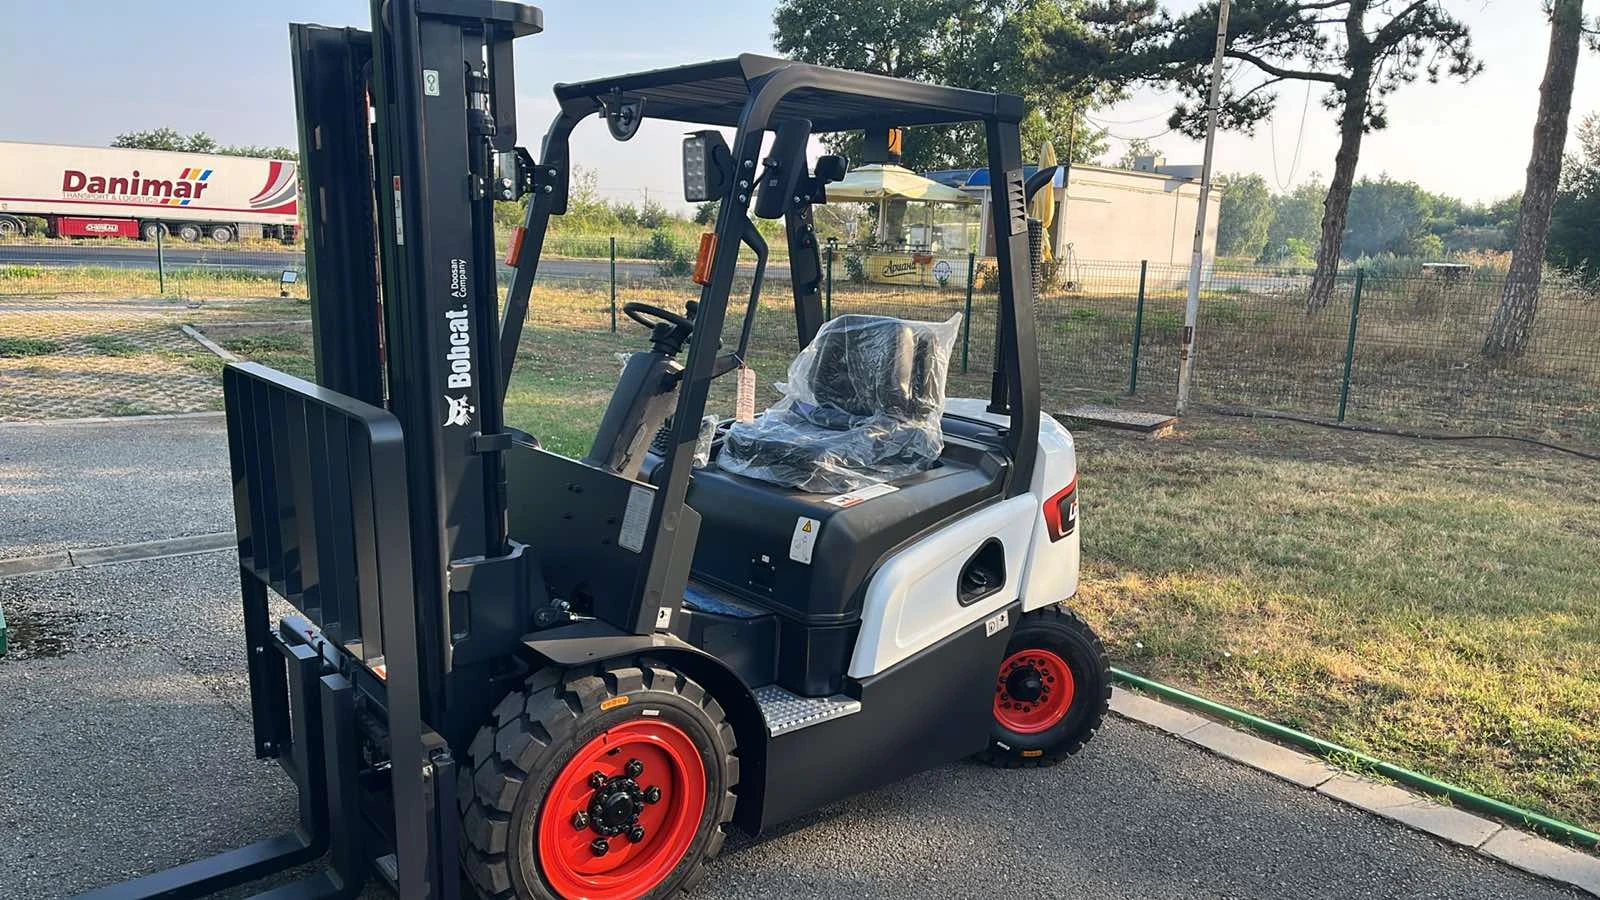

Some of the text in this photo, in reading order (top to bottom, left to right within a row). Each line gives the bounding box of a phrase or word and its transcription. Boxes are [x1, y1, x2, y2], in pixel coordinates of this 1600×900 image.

[62, 170, 208, 199] Danimar
[63, 192, 109, 201] TRANSPORT
[119, 195, 159, 203] LOGISTICS
[459, 259, 467, 297] Company
